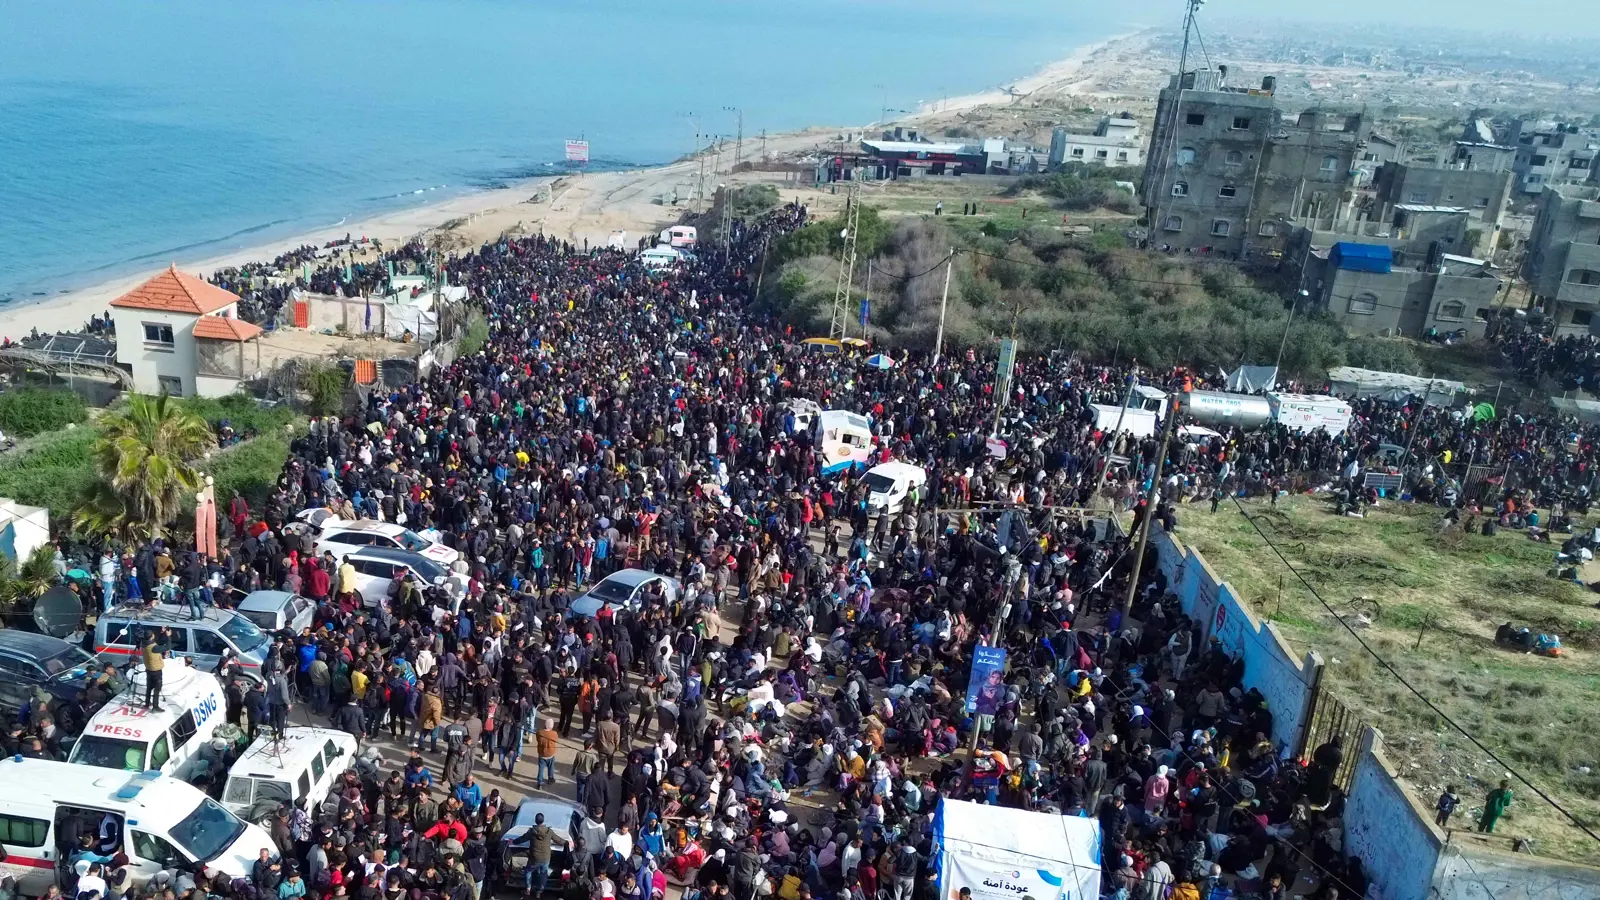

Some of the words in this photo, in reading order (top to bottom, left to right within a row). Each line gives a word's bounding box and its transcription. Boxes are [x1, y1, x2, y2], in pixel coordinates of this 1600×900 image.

[428, 545, 449, 555] TV
[193, 692, 216, 727] DSNG
[93, 724, 142, 738] PRESS
[982, 877, 1004, 889] آمنة
[1004, 881, 1029, 894] عودة
